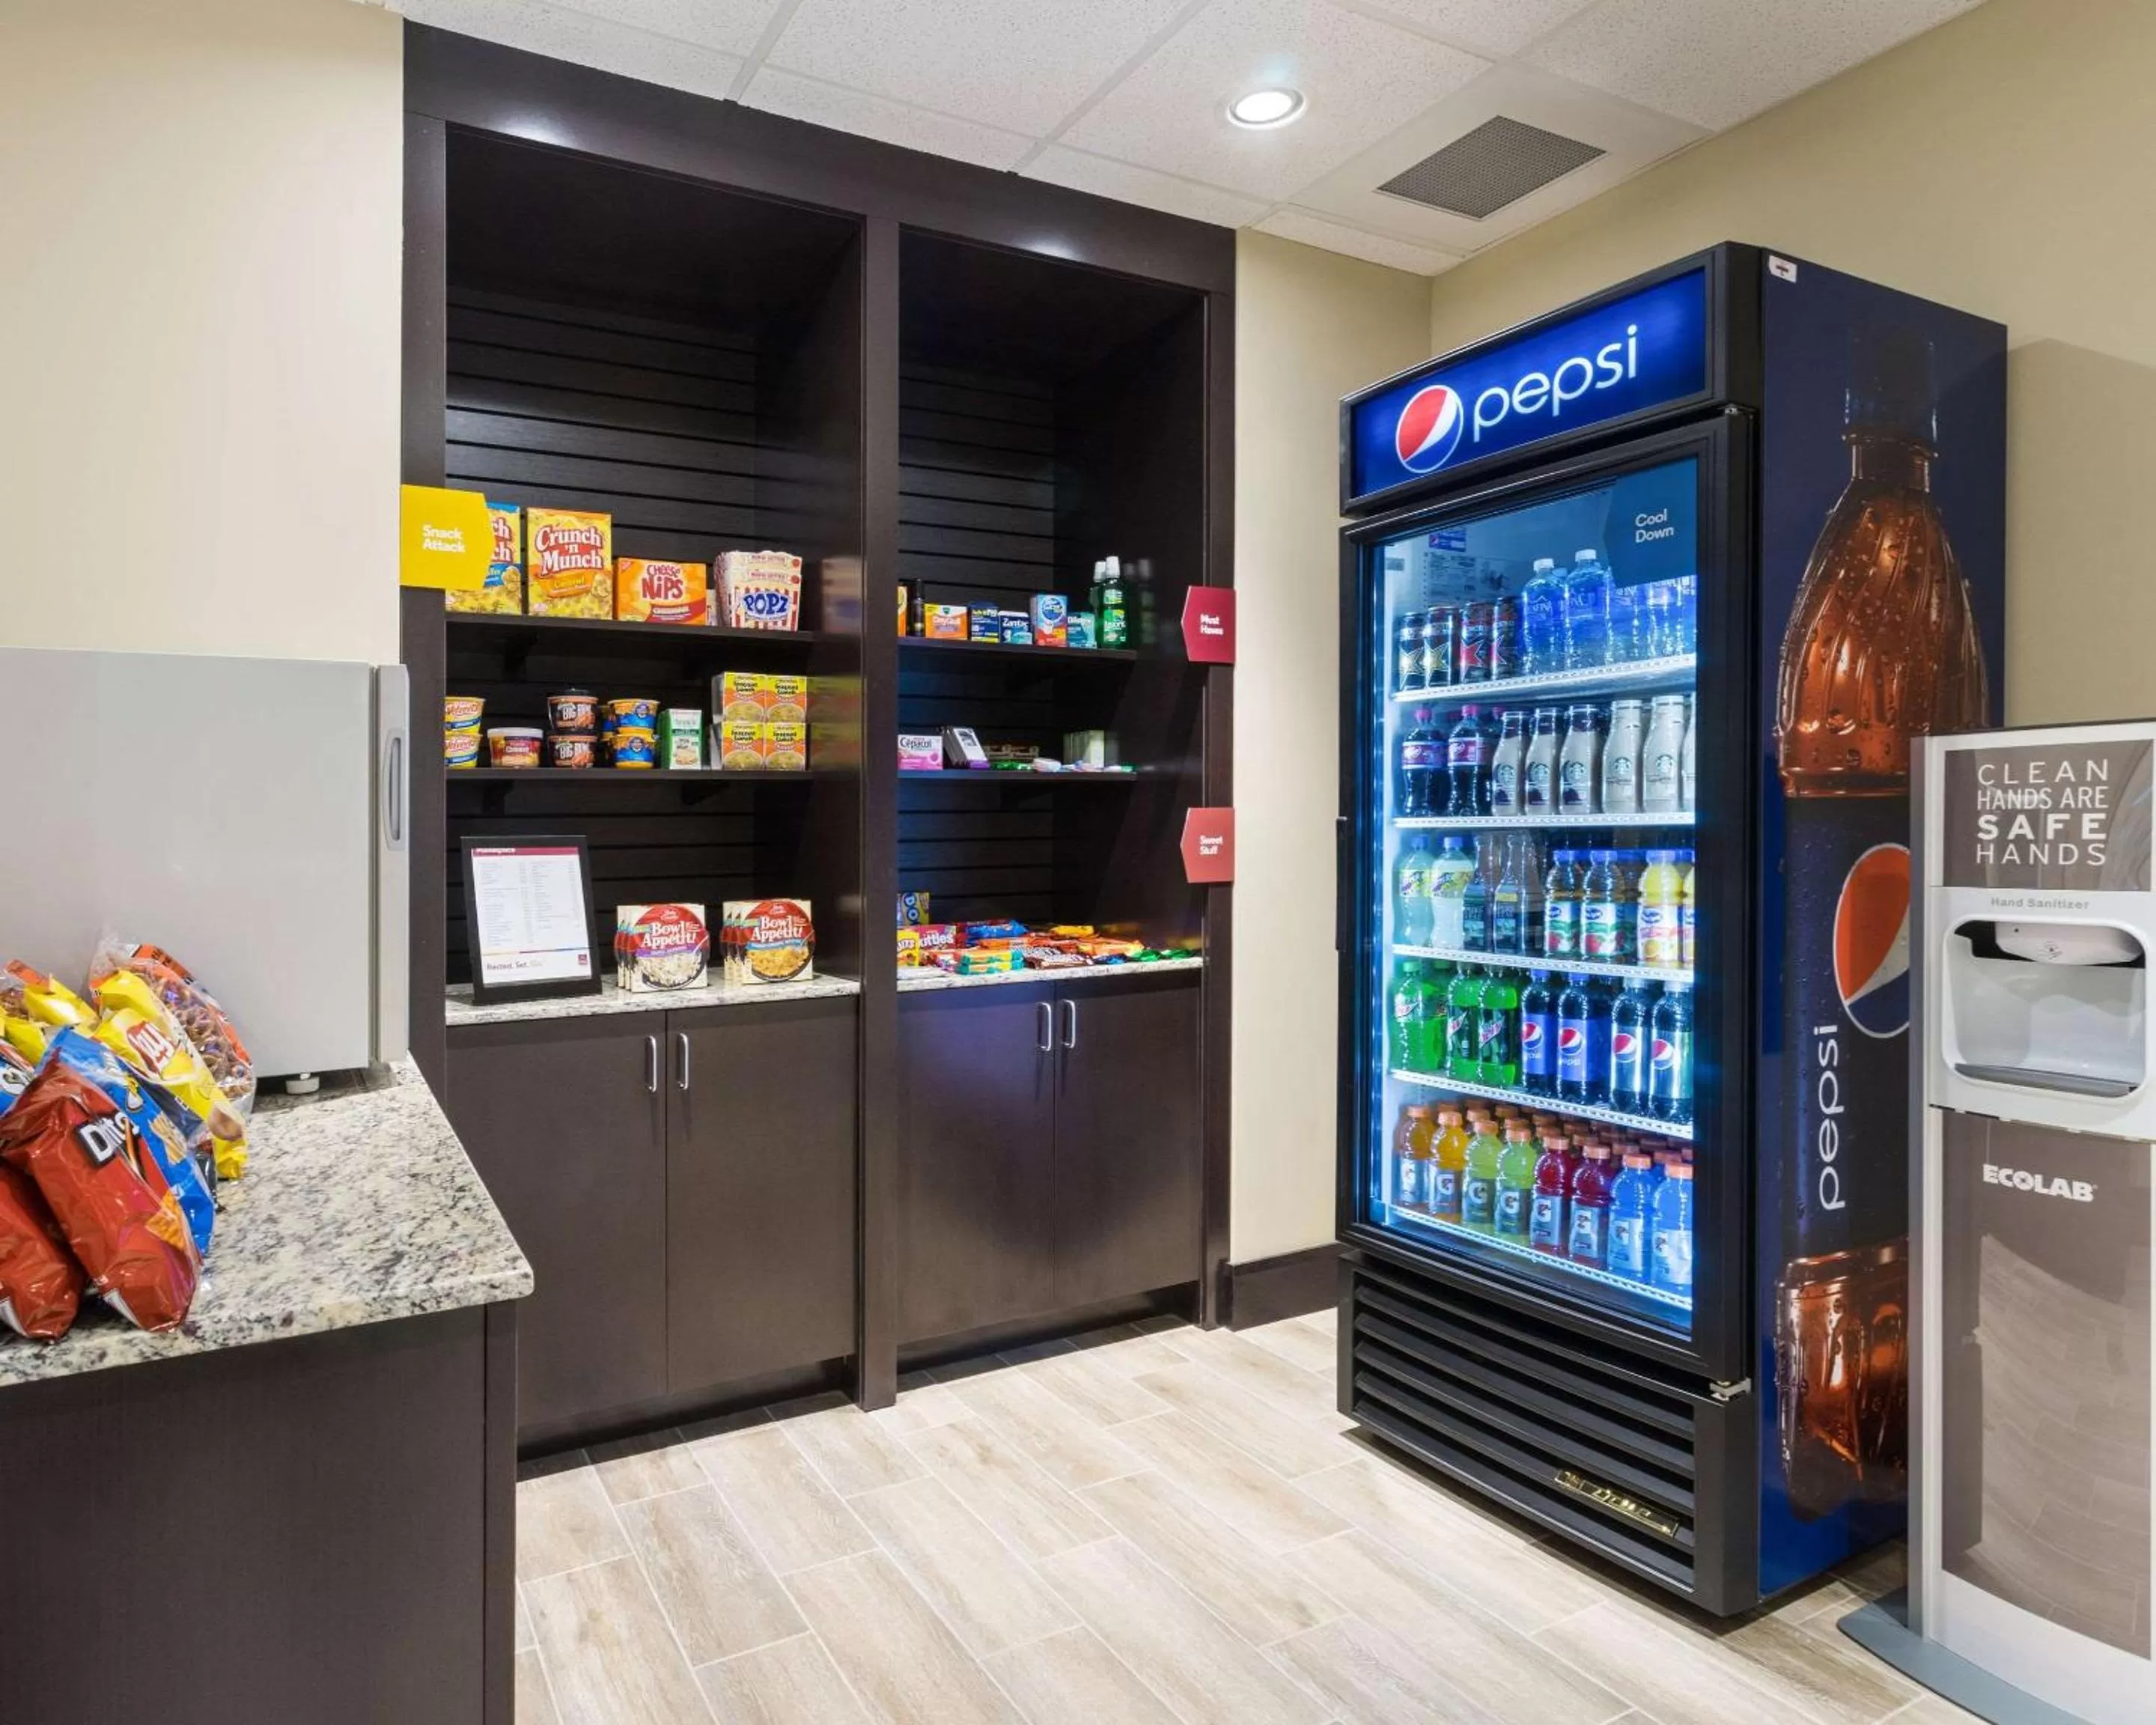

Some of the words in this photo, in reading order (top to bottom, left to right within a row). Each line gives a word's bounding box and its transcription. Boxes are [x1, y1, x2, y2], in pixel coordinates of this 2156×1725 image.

[1473, 323, 1638, 443] pepsi
[1635, 508, 1667, 527] Cool
[423, 526, 462, 539] Snack
[535, 526, 603, 552] Crunch
[1635, 526, 1675, 543] Down
[423, 538, 465, 553] Attack
[541, 553, 603, 575] Munch
[743, 593, 789, 615] POPZ
[1201, 614, 1219, 624] Must
[1201, 624, 1223, 636] Haves
[1978, 758, 2108, 785] CLEAN
[1977, 788, 2053, 810] HANDS
[2059, 785, 2109, 809] ARE
[1977, 812, 2107, 840] SAFE
[1200, 836, 1223, 845] Sweet
[1200, 845, 1218, 855] Stuff
[1976, 843, 2107, 866] HANDS
[1991, 898, 2023, 908] Hand
[2029, 898, 2089, 910] Sanitizer
[651, 920, 684, 935] Bowl
[760, 915, 792, 930] Bowl
[1814, 1024, 1845, 1211] pepsi
[1983, 1164, 2094, 1202] ECOLAB
[1500, 1191, 1520, 1214] G
